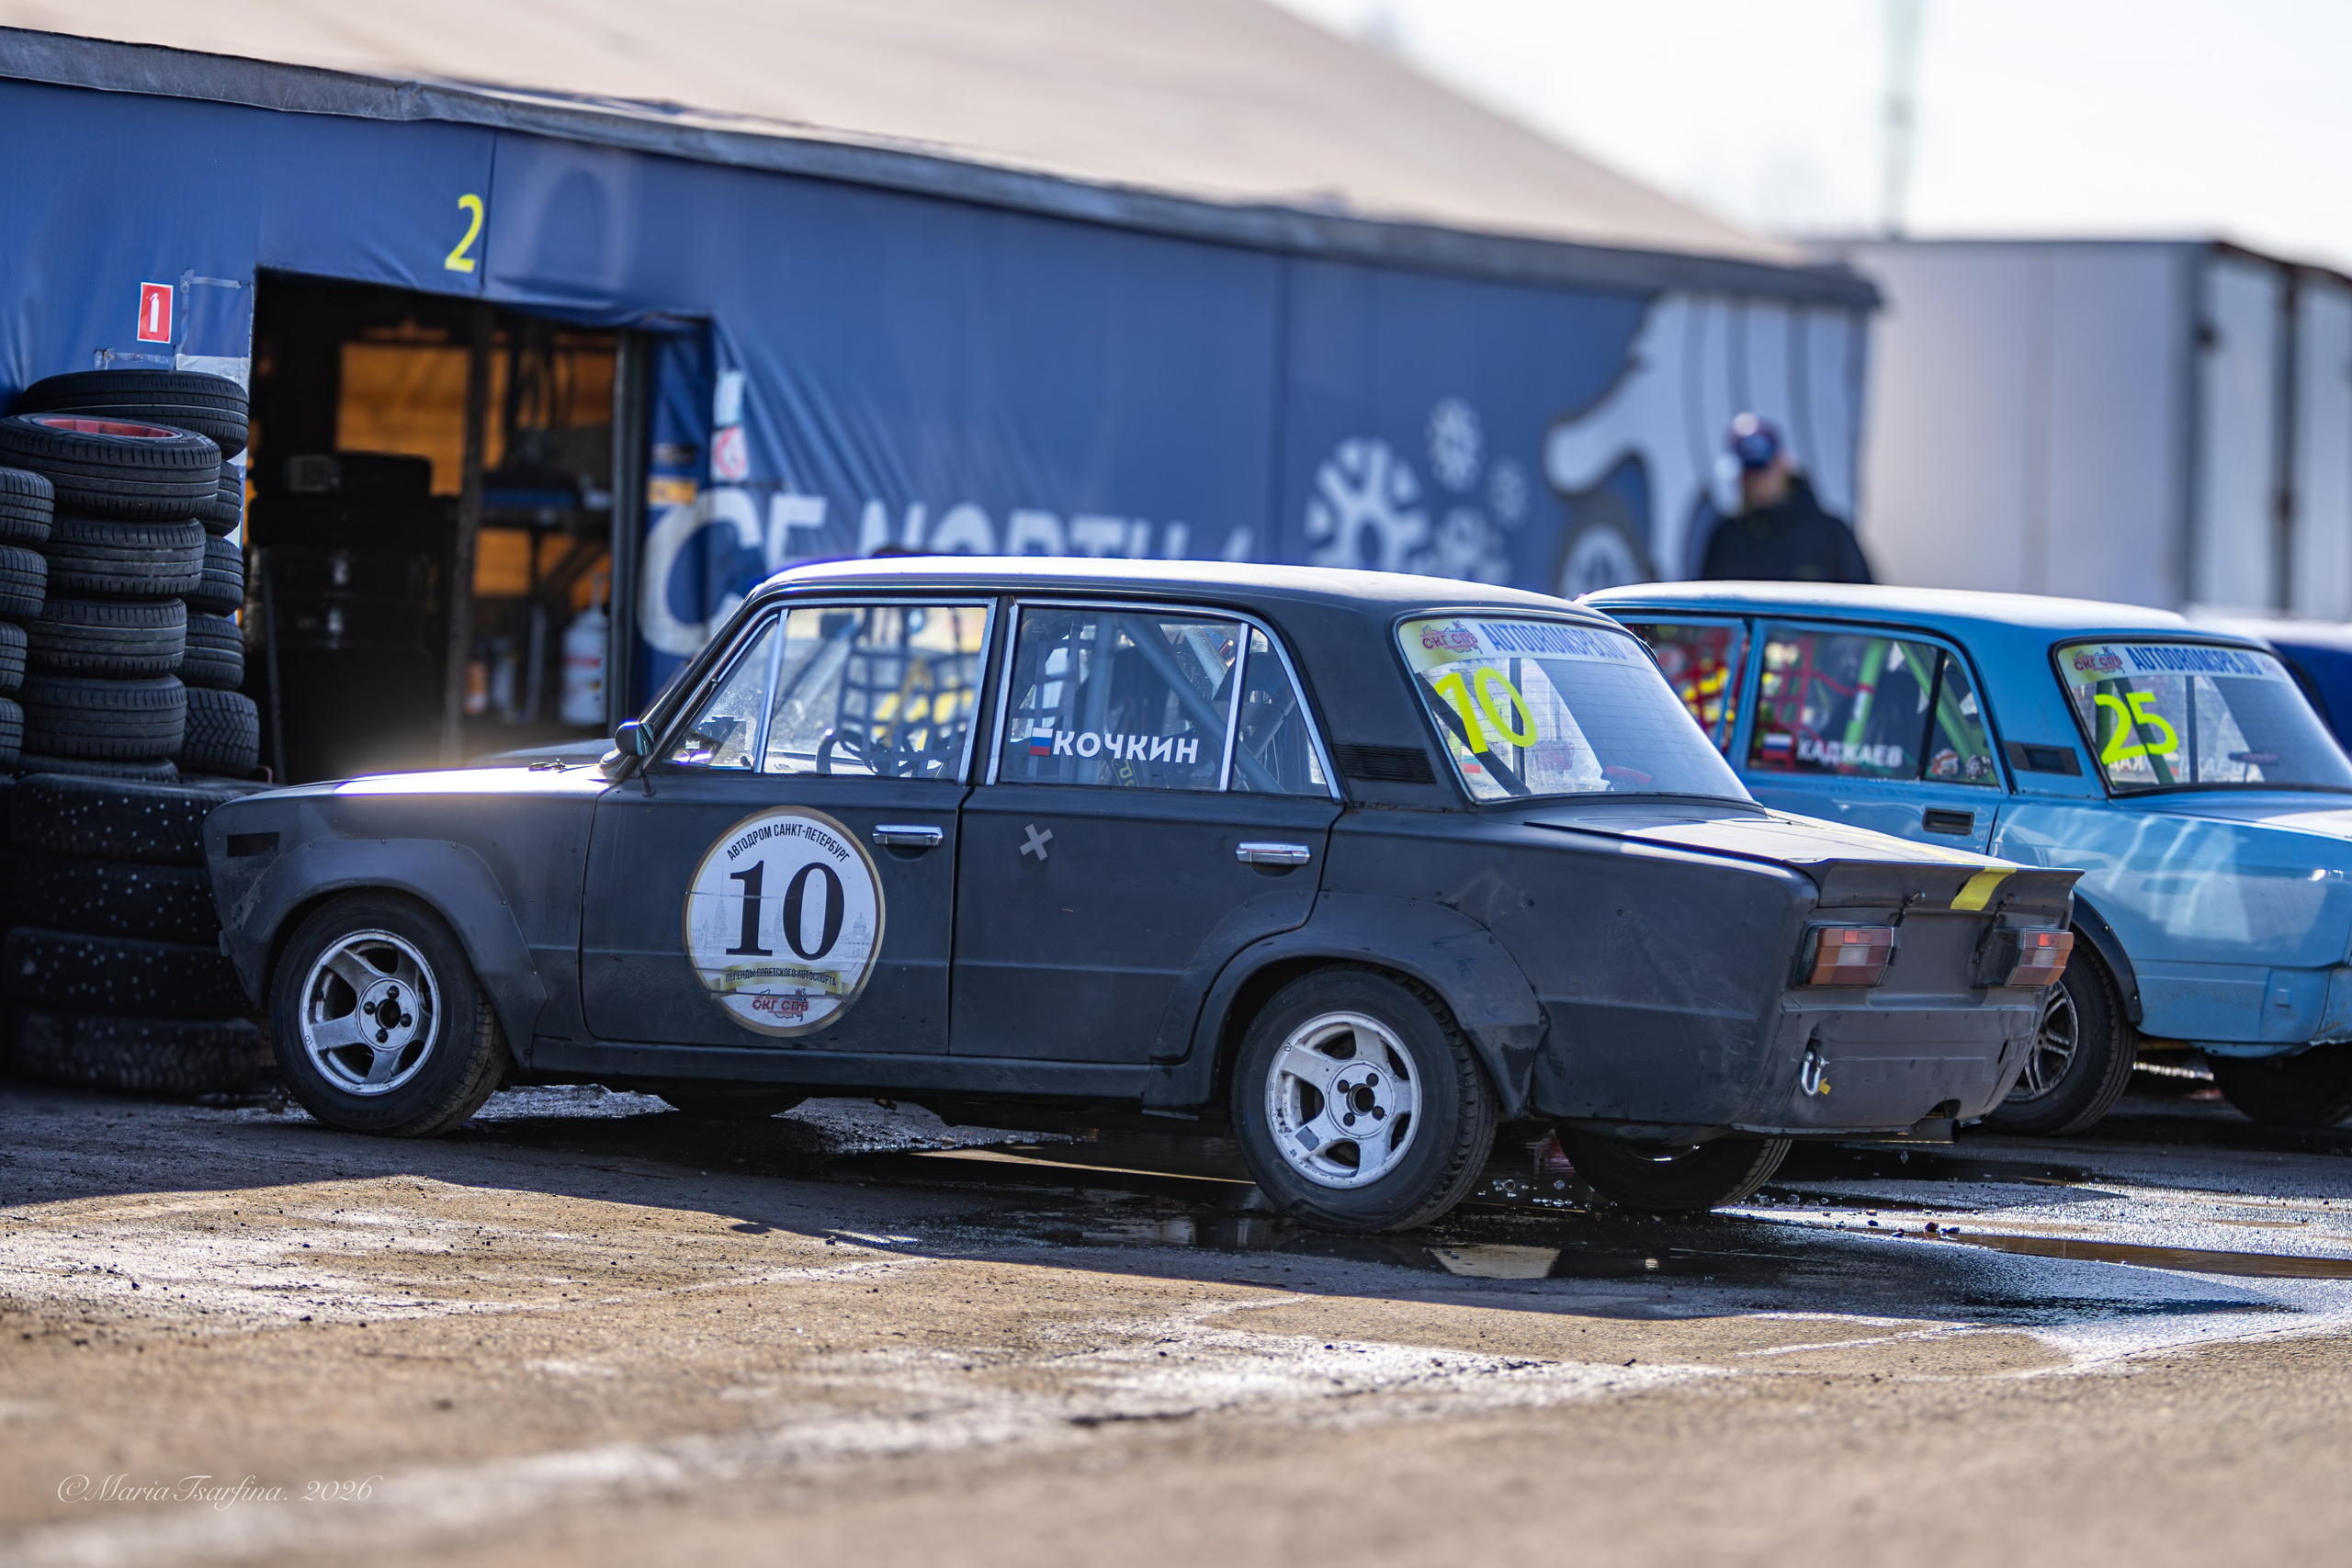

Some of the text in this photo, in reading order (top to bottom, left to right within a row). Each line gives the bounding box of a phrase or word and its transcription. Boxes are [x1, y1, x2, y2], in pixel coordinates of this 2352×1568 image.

[445, 192, 483, 273] 2
[1421, 634, 1449, 649] СКГ
[1451, 632, 1479, 645] СПБ
[1477, 622, 1629, 661] AUTODROMSPB.SU
[2073, 657, 2098, 671] СКГ
[2124, 646, 2264, 676] AUTODROMSPB.SU
[1434, 667, 1537, 754] 10
[2093, 692, 2178, 765] 25
[1053, 730, 1199, 764] КОЧКИН
[727, 823, 851, 863] АВТОДРОМ САНКТ-ПЕТЕРБУРГ
[725, 860, 845, 961] 10
[725, 967, 838, 987] ЛЕГЕНДЫ СОВЕТСКОГО АВТОСПОРТА
[752, 999, 809, 1012] СКГ СПБ
